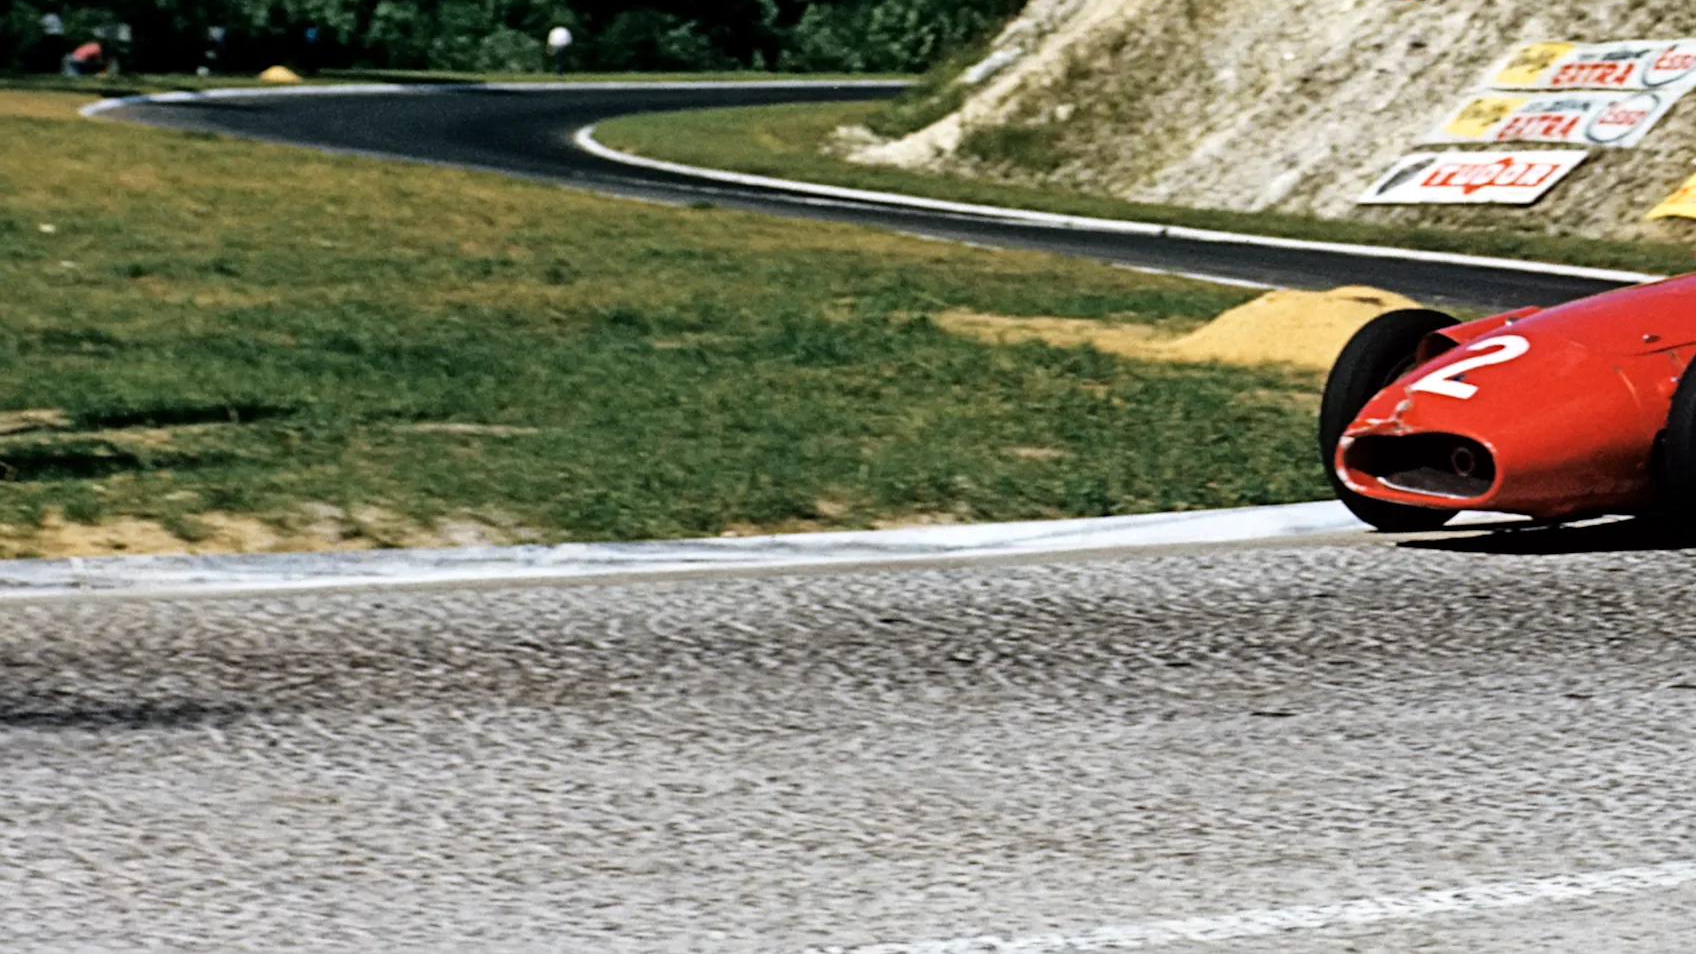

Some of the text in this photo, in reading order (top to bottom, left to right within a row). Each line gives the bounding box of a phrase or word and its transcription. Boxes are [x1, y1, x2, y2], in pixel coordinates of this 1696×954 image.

[1551, 62, 1636, 85] EXTRA
[1497, 114, 1580, 142] EXTRA
[1425, 161, 1559, 187] TUDOR
[1409, 334, 1530, 399] 2
